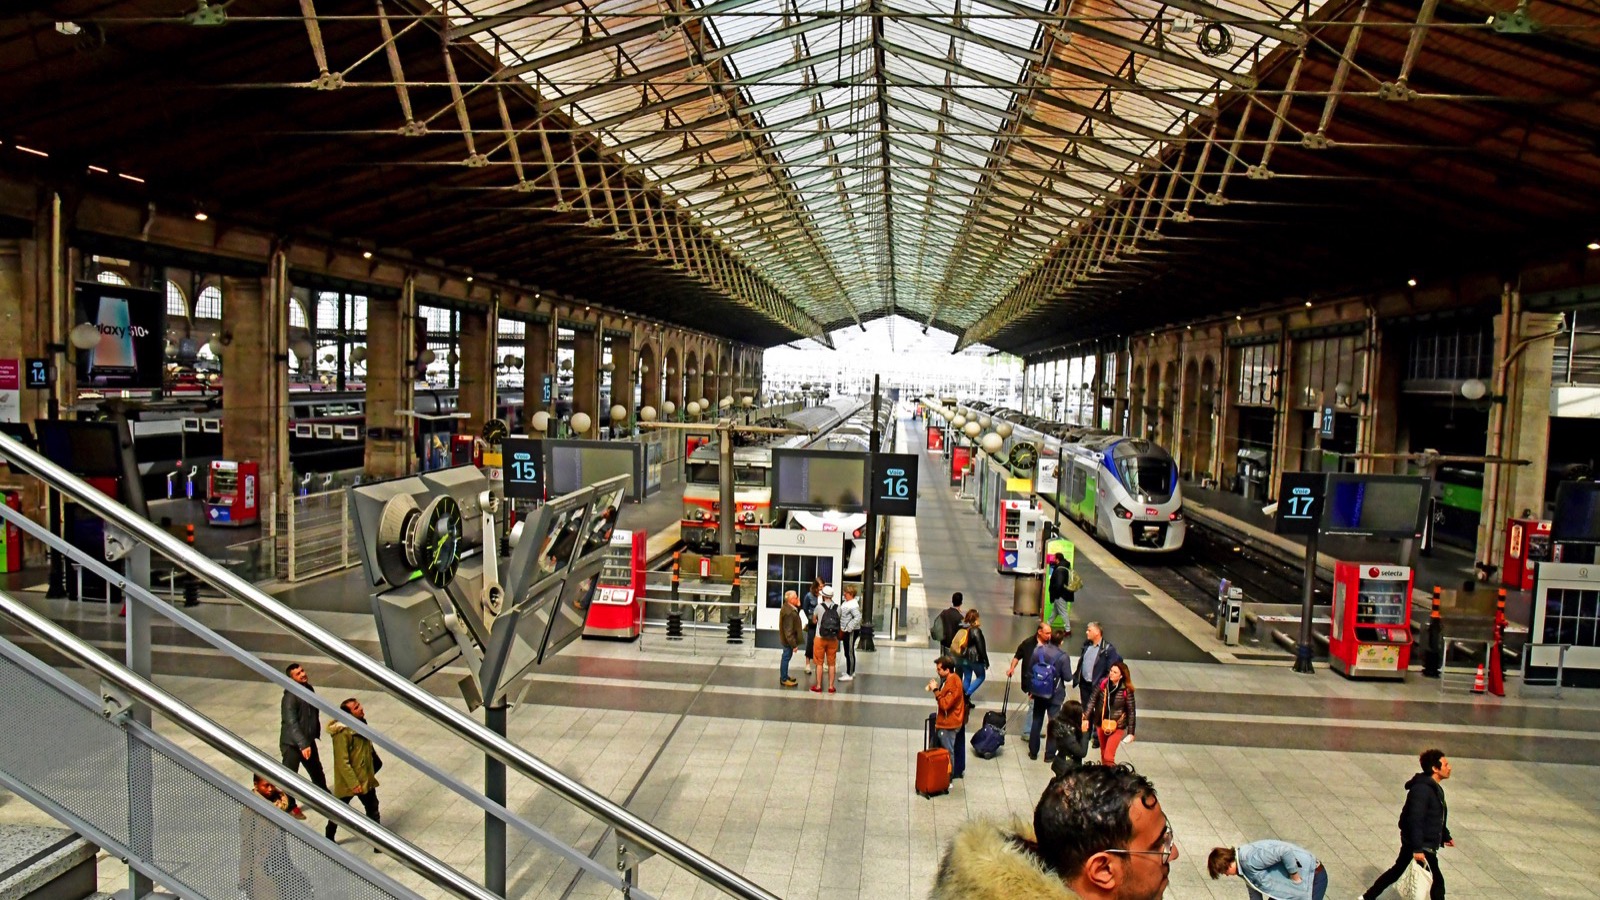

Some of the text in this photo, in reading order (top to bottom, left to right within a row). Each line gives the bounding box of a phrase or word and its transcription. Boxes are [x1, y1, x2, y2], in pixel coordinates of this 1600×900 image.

[31, 368, 46, 382] 14
[543, 384, 551, 399] 15
[1323, 415, 1333, 431] 17
[511, 461, 536, 480] 15
[883, 477, 909, 497] 16
[1288, 496, 1315, 515] 17
